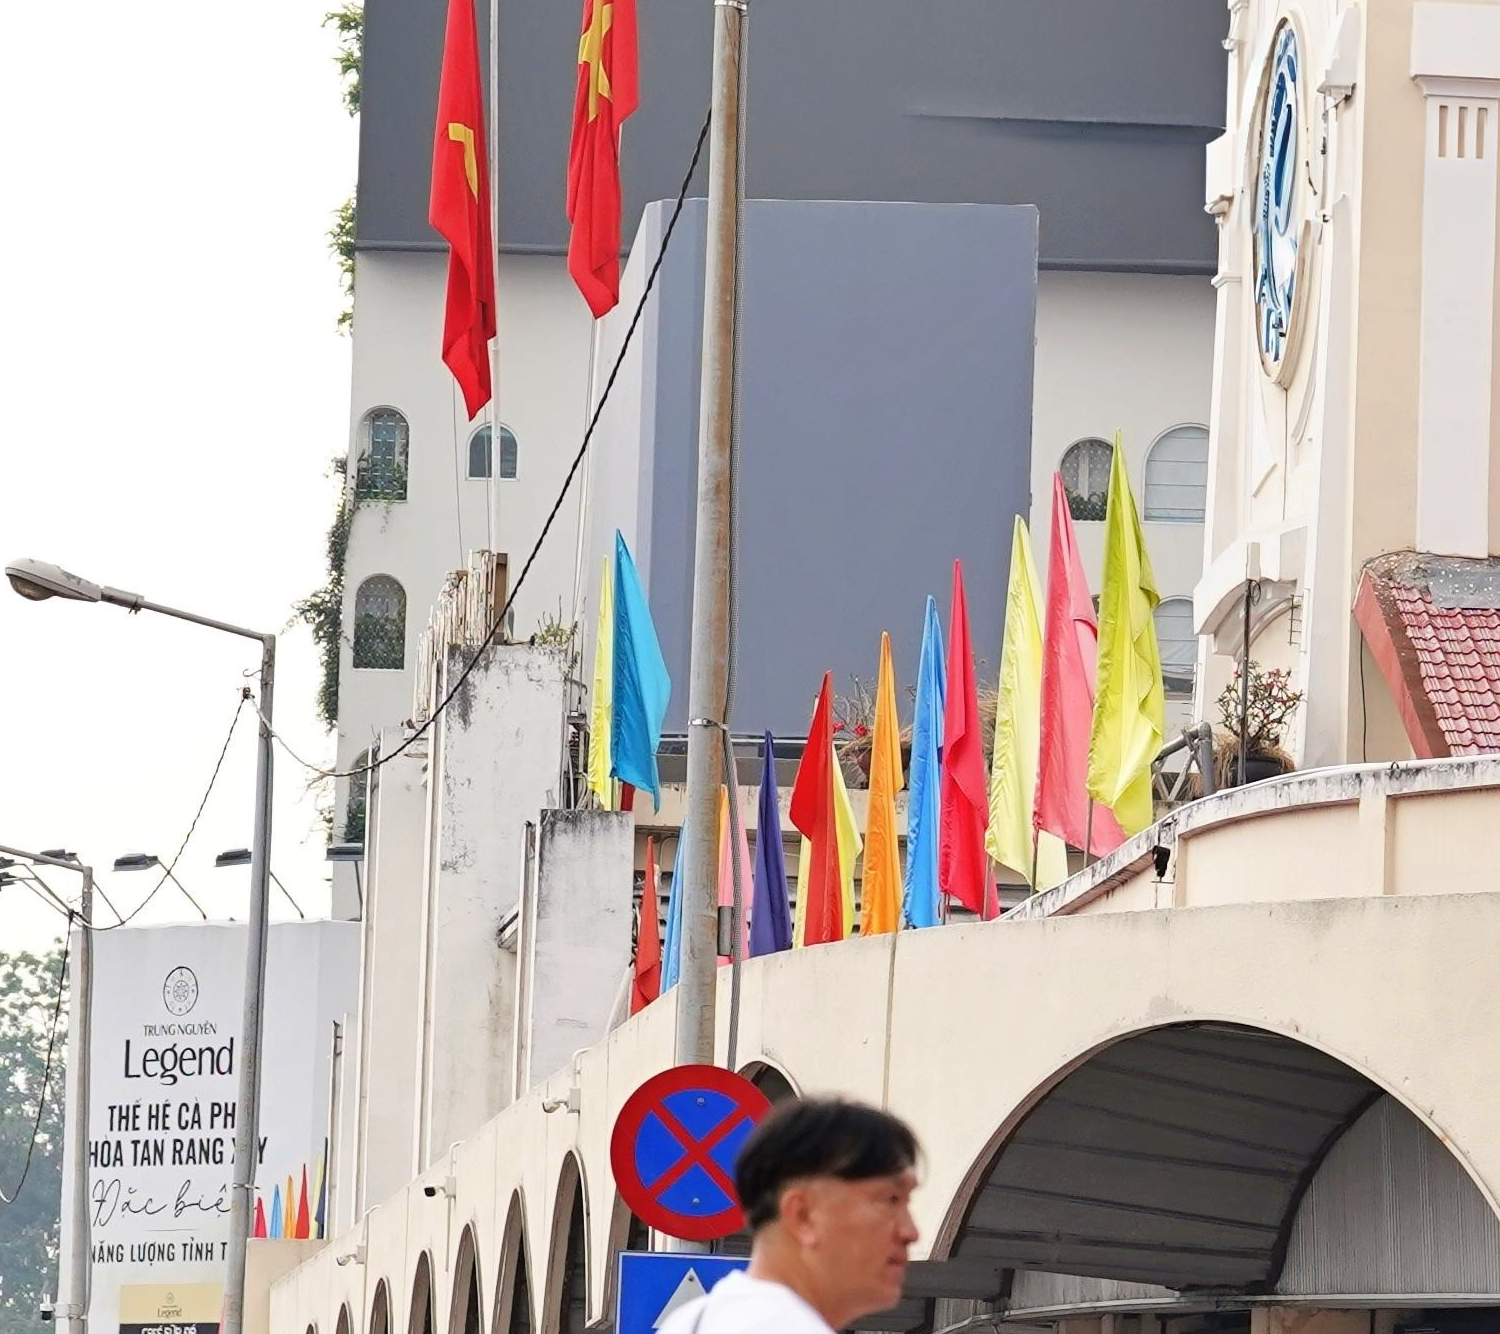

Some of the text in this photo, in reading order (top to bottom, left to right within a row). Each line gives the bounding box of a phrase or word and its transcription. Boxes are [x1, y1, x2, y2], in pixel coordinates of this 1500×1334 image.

[143, 1023, 175, 1036] TRUNG
[124, 1037, 234, 1086] Legend
[177, 1097, 201, 1131] CÀ
[210, 1102, 237, 1130] PH
[131, 1139, 165, 1167] TAN
[172, 1137, 224, 1166] RANG
[174, 1179, 232, 1218] biệ
